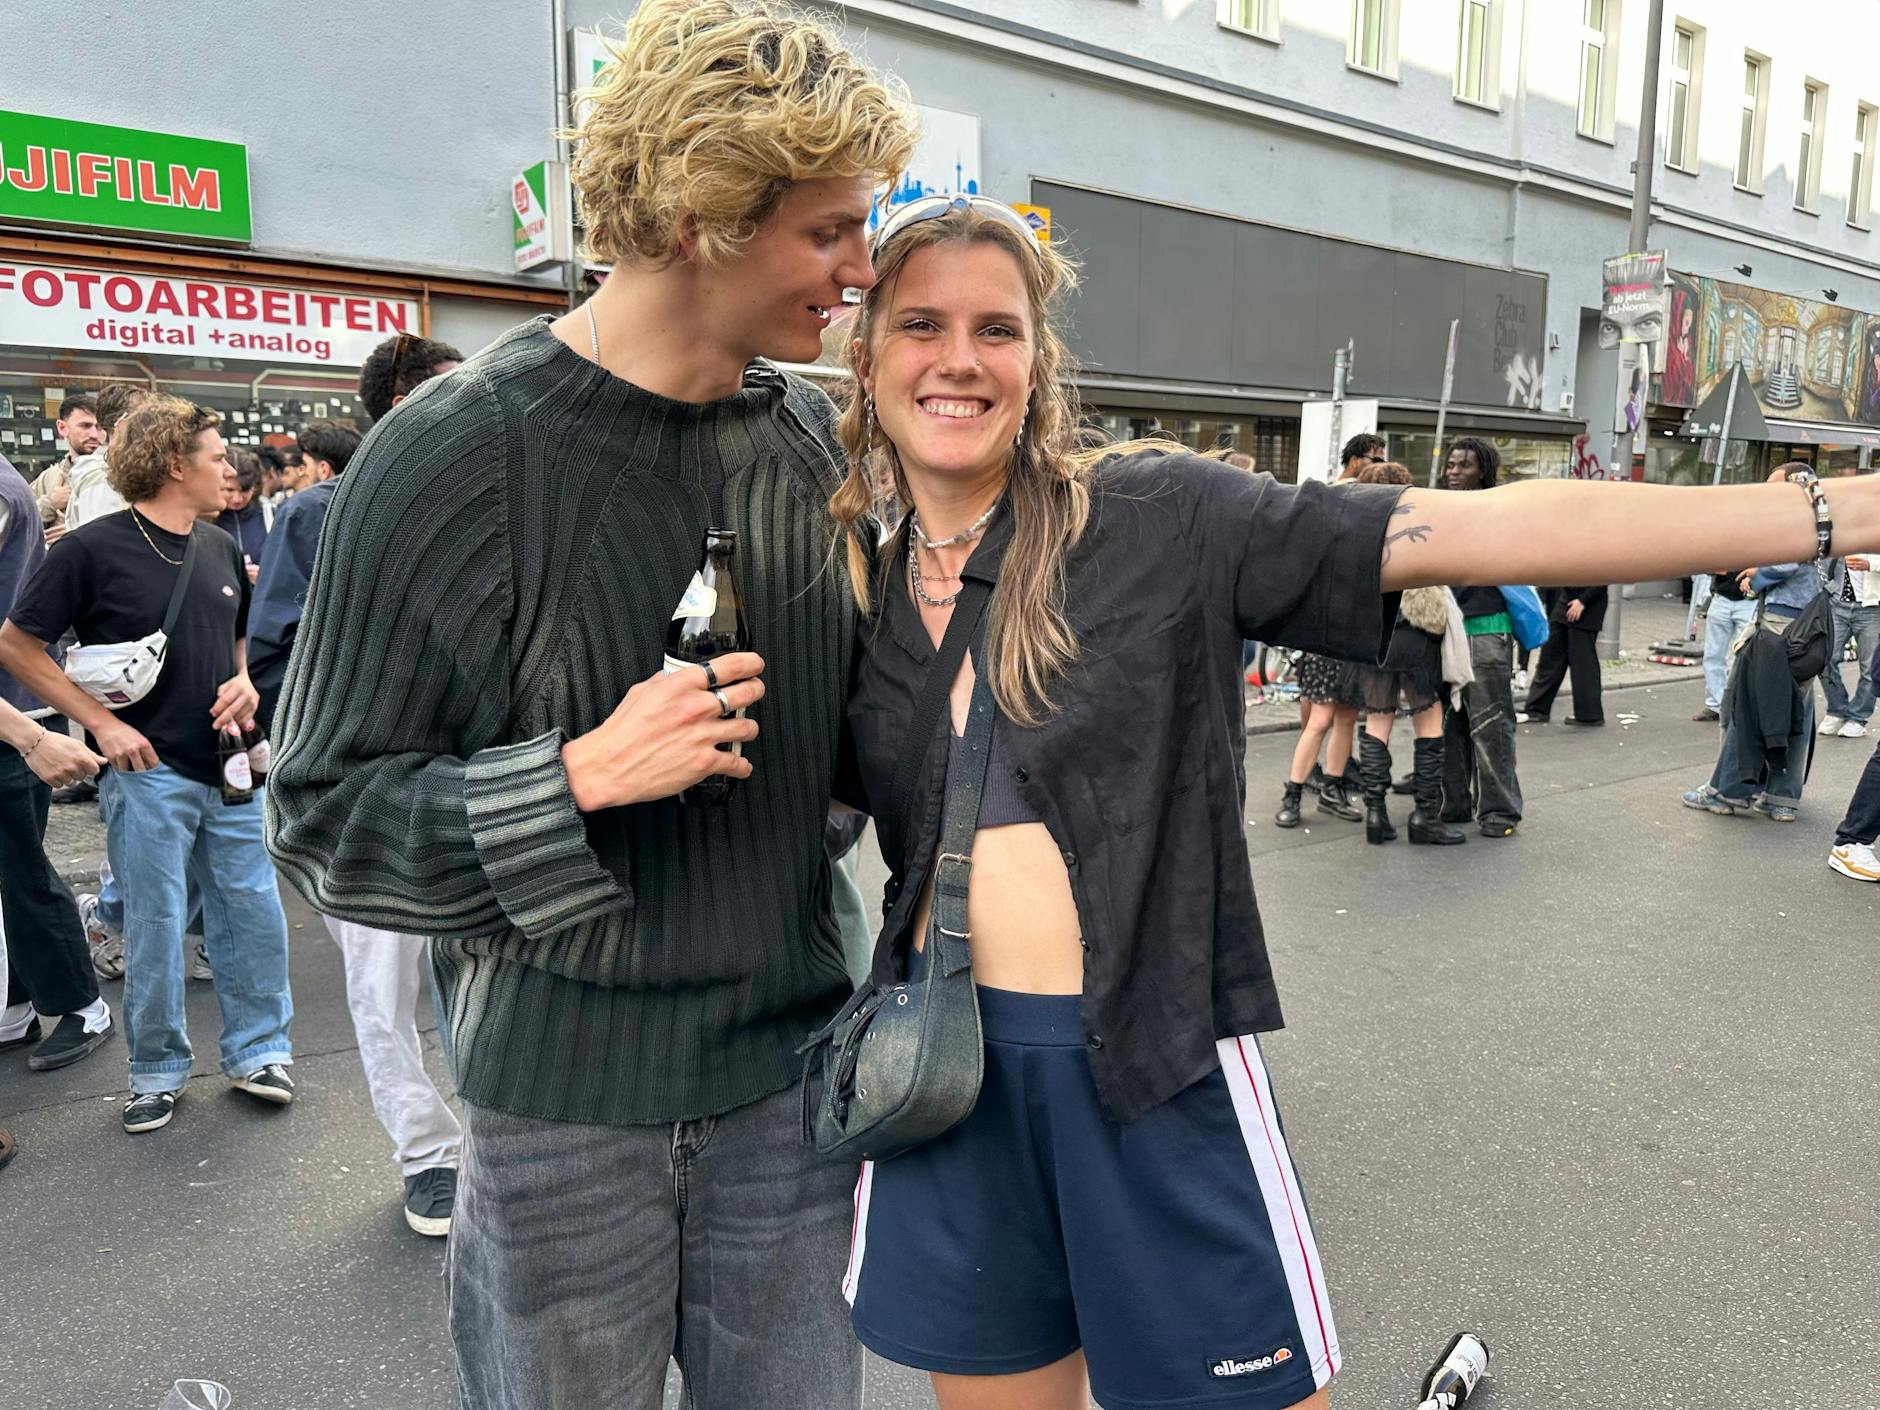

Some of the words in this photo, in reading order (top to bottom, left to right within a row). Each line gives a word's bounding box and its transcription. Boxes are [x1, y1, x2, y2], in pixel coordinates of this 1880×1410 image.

[0, 142, 221, 212] JIFILM
[86, 318, 195, 349] digital
[208, 331, 331, 361] +analog
[1213, 1356, 1273, 1376] ellesse
